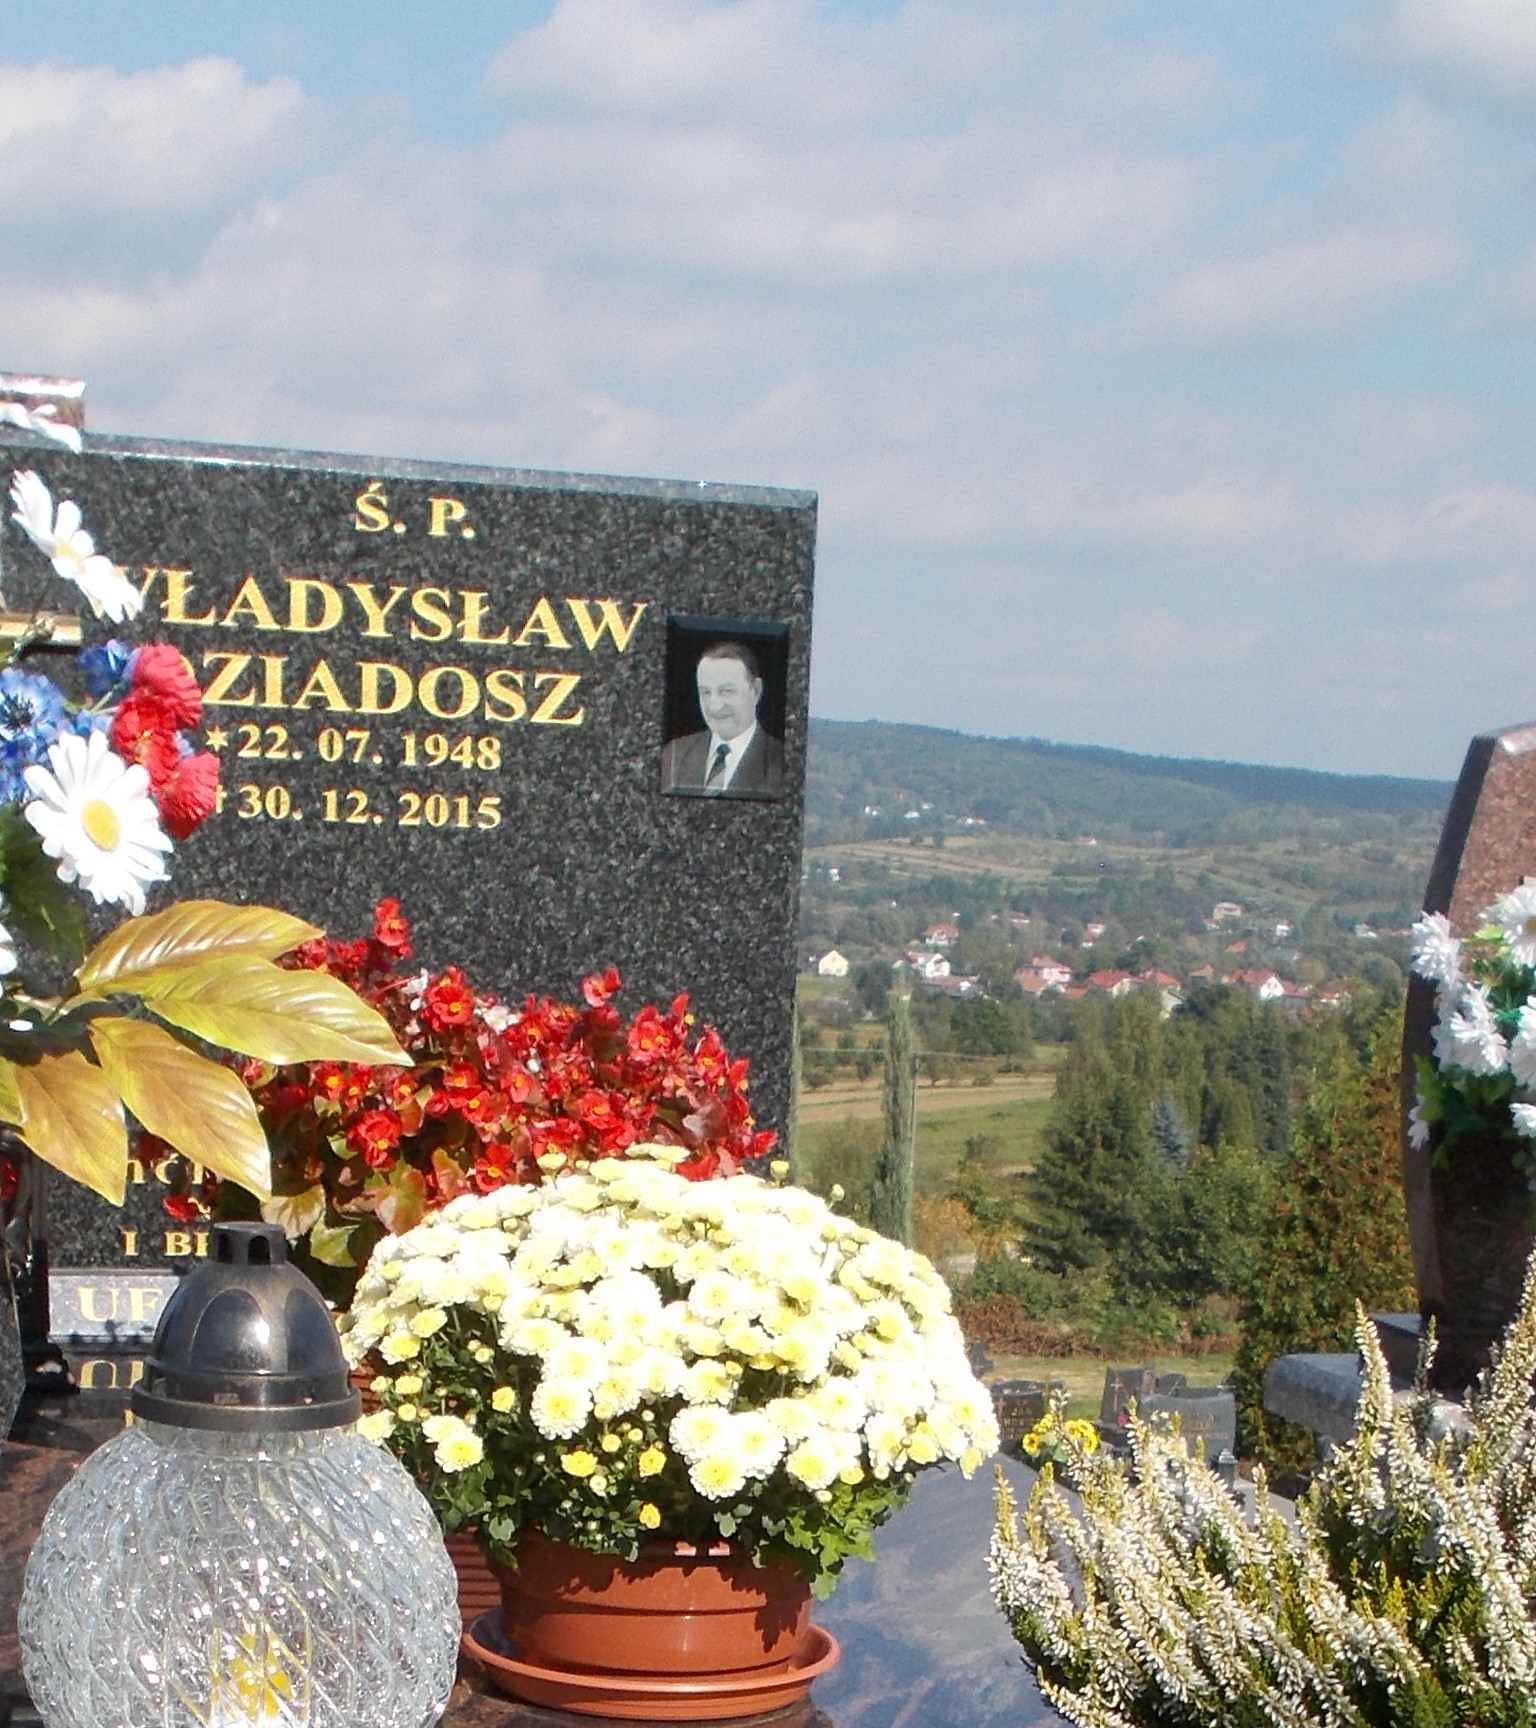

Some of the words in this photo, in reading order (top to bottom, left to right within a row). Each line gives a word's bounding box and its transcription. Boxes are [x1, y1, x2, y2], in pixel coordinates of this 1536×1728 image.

[355, 480, 407, 534] Ś.
[427, 496, 476, 539] P.
[181, 651, 586, 726] ZIADOSZ
[237, 724, 303, 760] 22.
[318, 727, 383, 765] 07.
[402, 733, 502, 770] 1948
[237, 784, 303, 821] 30.
[322, 788, 383, 825] 12.
[398, 793, 502, 829] 2015
